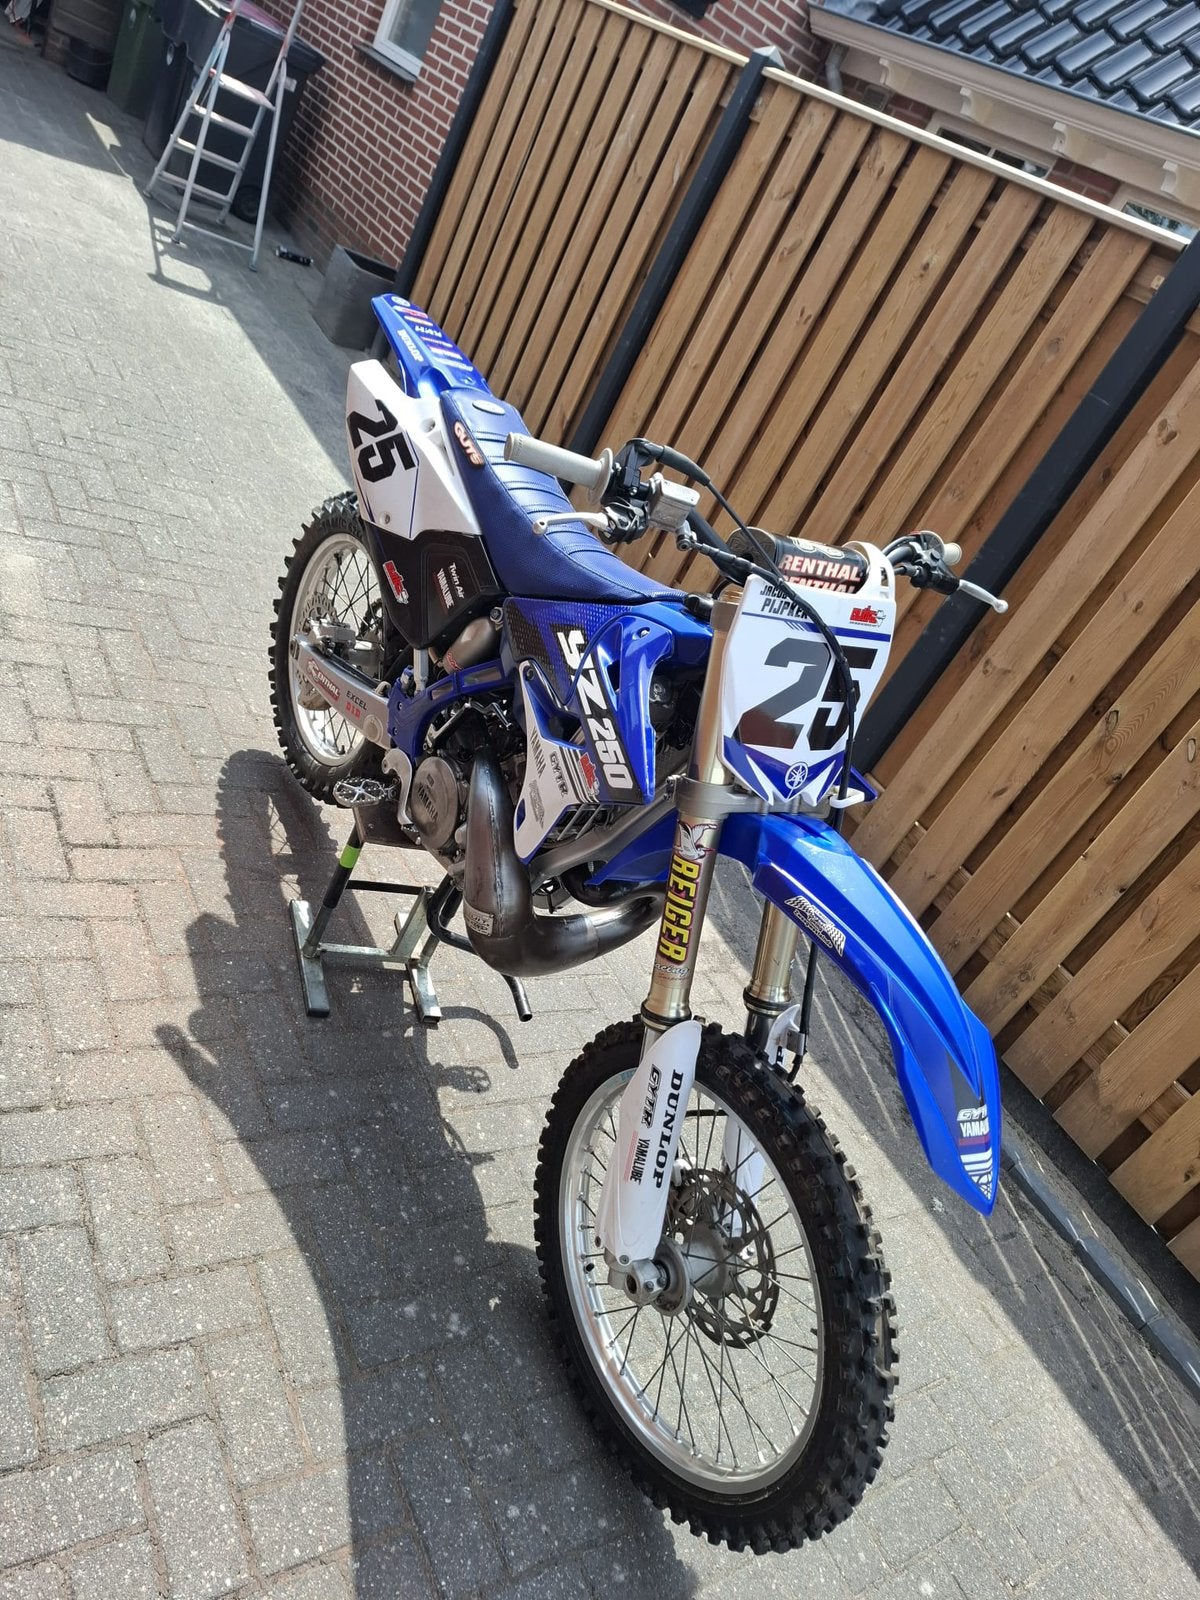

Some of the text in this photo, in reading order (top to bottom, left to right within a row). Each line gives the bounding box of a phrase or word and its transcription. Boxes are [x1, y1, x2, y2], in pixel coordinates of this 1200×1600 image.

[397, 329, 424, 362] DUNLOP
[346, 399, 416, 483] 25
[453, 421, 484, 469] GUTS
[449, 561, 465, 599] Twin Air
[779, 553, 861, 583] RENTHAL
[346, 690, 368, 711] EXCEL
[733, 636, 879, 752] 25
[530, 726, 547, 778] YAMAHA
[549, 751, 569, 798] GYTR
[417, 782, 439, 822] YAMAHA
[659, 854, 699, 965] REIGER
[654, 963, 690, 979] acing
[641, 1063, 662, 1129] GYTR
[653, 1068, 684, 1190] DUNLOP
[630, 1138, 651, 1186] YAMALUBE
